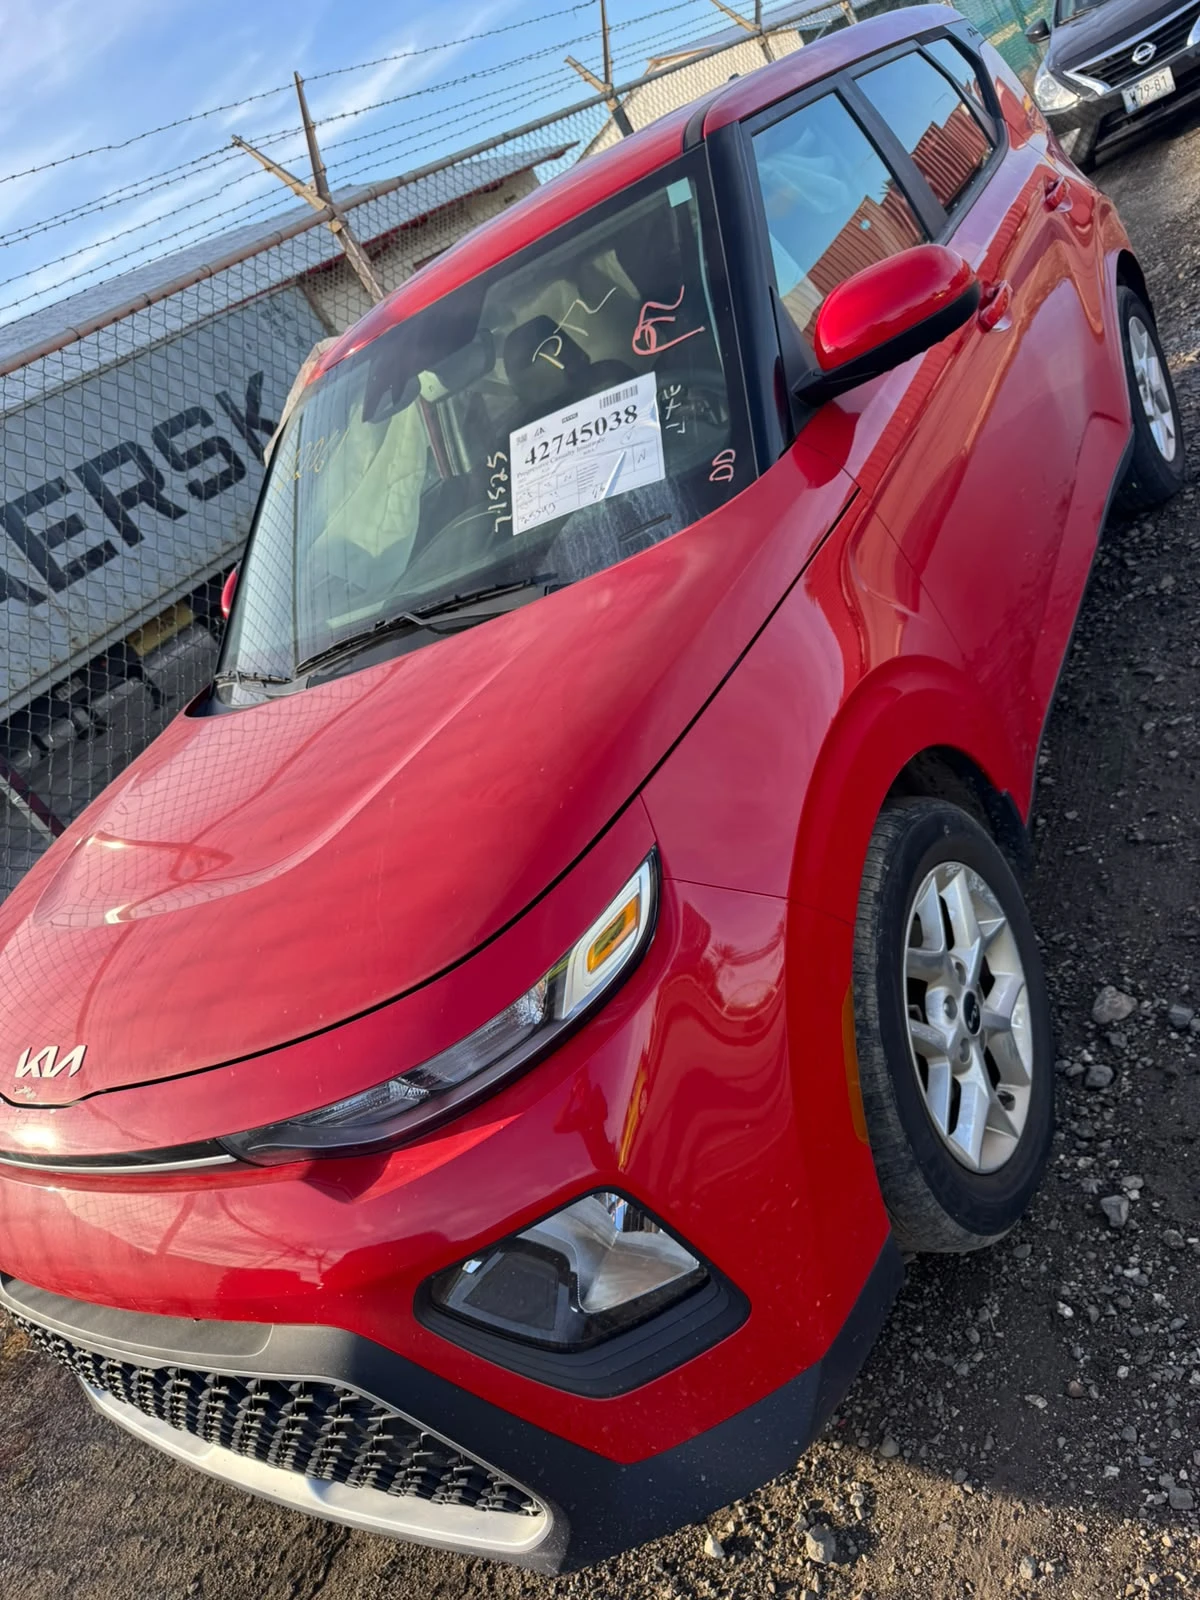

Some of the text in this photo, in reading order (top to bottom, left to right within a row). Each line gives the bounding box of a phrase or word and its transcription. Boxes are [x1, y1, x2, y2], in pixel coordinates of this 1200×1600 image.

[525, 404, 638, 465] 42745038
[0, 371, 279, 607] ERSK
[14, 1044, 88, 1077] KIA
